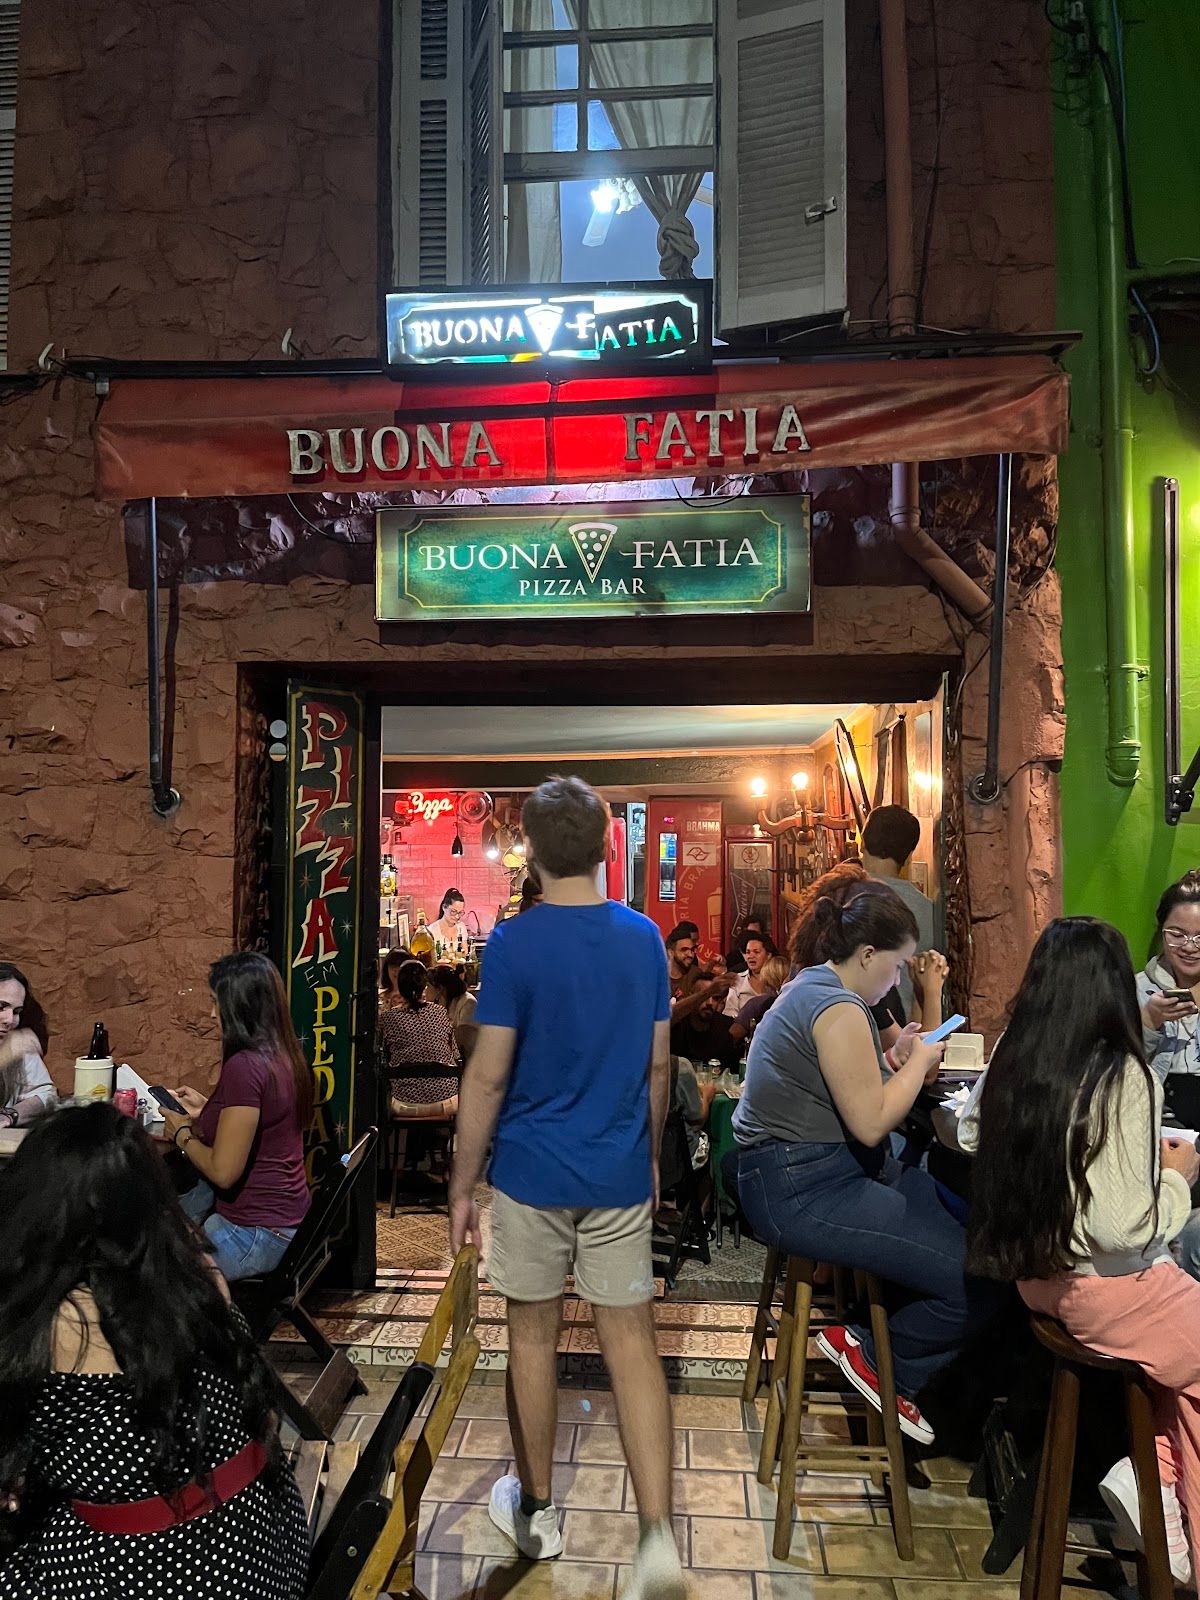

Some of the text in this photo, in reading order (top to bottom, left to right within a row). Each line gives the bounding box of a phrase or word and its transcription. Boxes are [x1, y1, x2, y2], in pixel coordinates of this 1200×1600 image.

[412, 313, 683, 351] BUONA FATIA
[286, 404, 812, 475] BUONA FATIA
[418, 537, 763, 571] BUONA FATIA
[519, 577, 646, 596] PIZZA BAR
[293, 704, 357, 967] PIZZA
[686, 821, 721, 832] BRAHMA
[304, 961, 341, 989] EM
